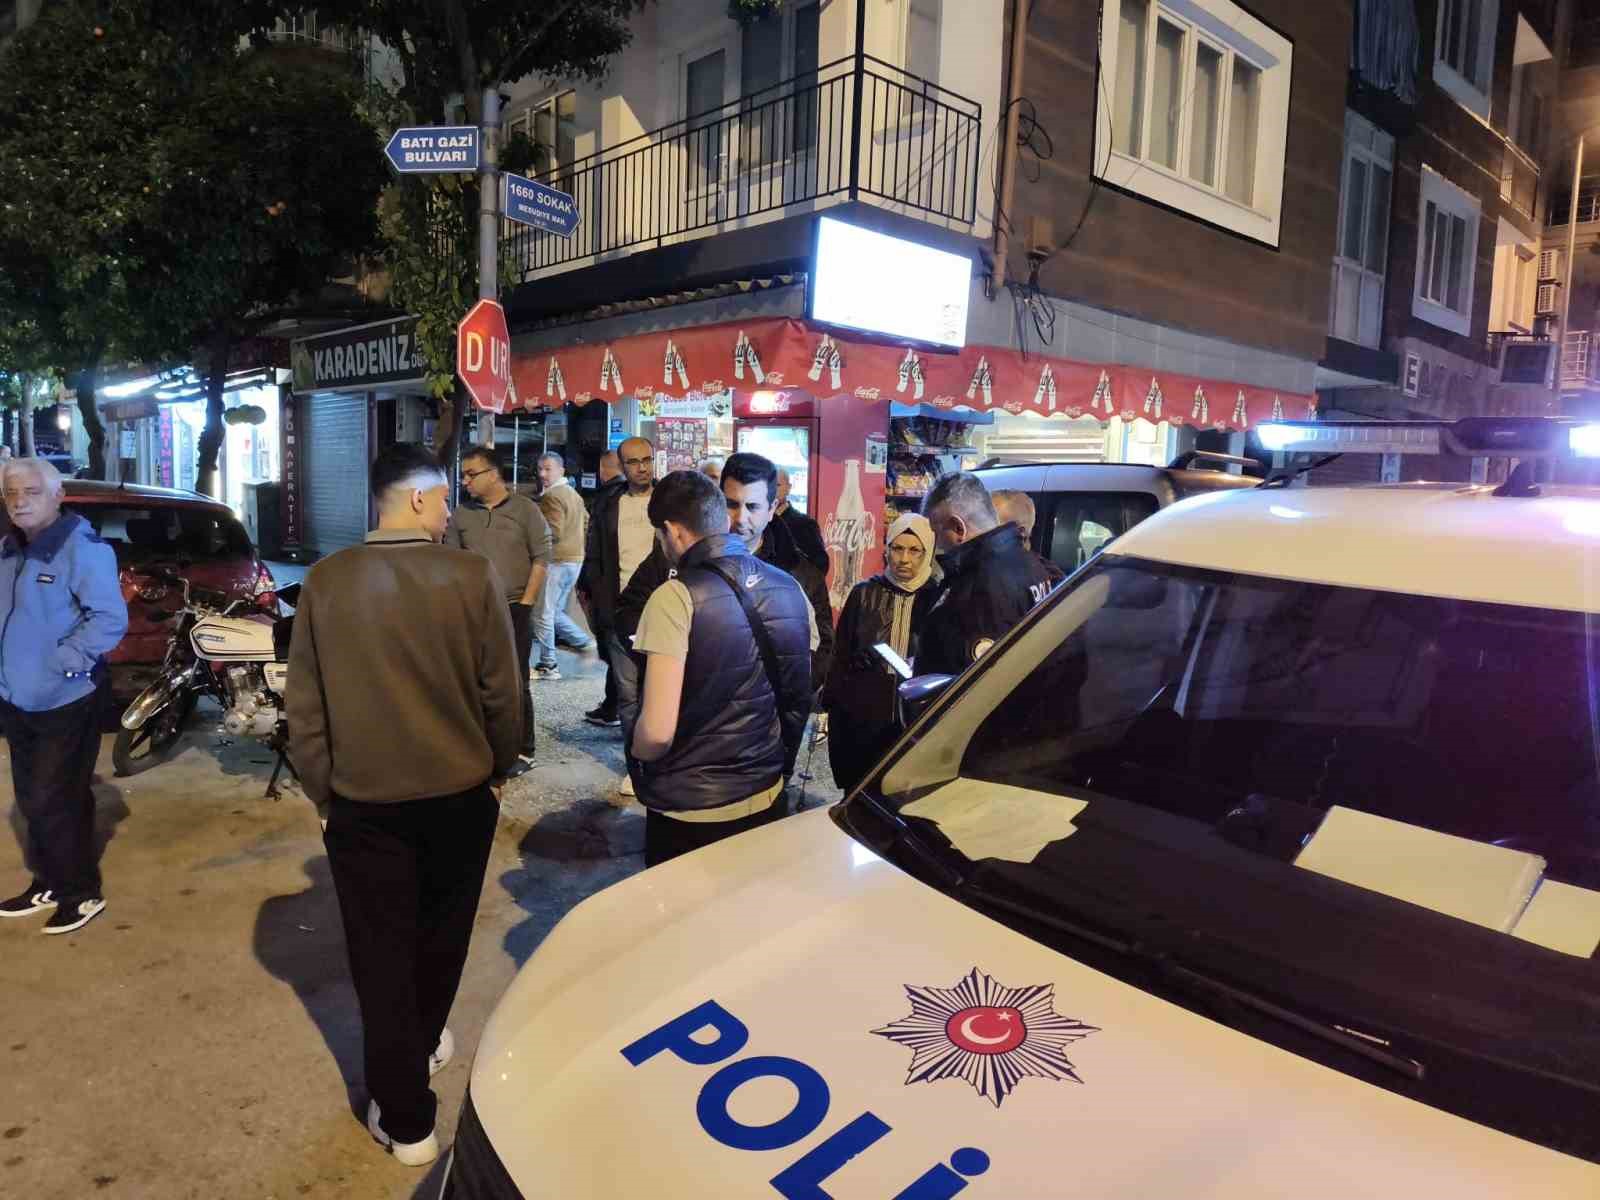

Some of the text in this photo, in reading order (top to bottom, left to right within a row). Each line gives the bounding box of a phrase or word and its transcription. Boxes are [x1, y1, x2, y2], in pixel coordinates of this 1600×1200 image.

[401, 133, 473, 149] BATI GAZİ
[405, 151, 466, 163] BULVARI
[510, 183, 572, 215] 1660 SOKAK
[314, 323, 411, 381] KARADENİZ
[466, 331, 510, 381] DUR
